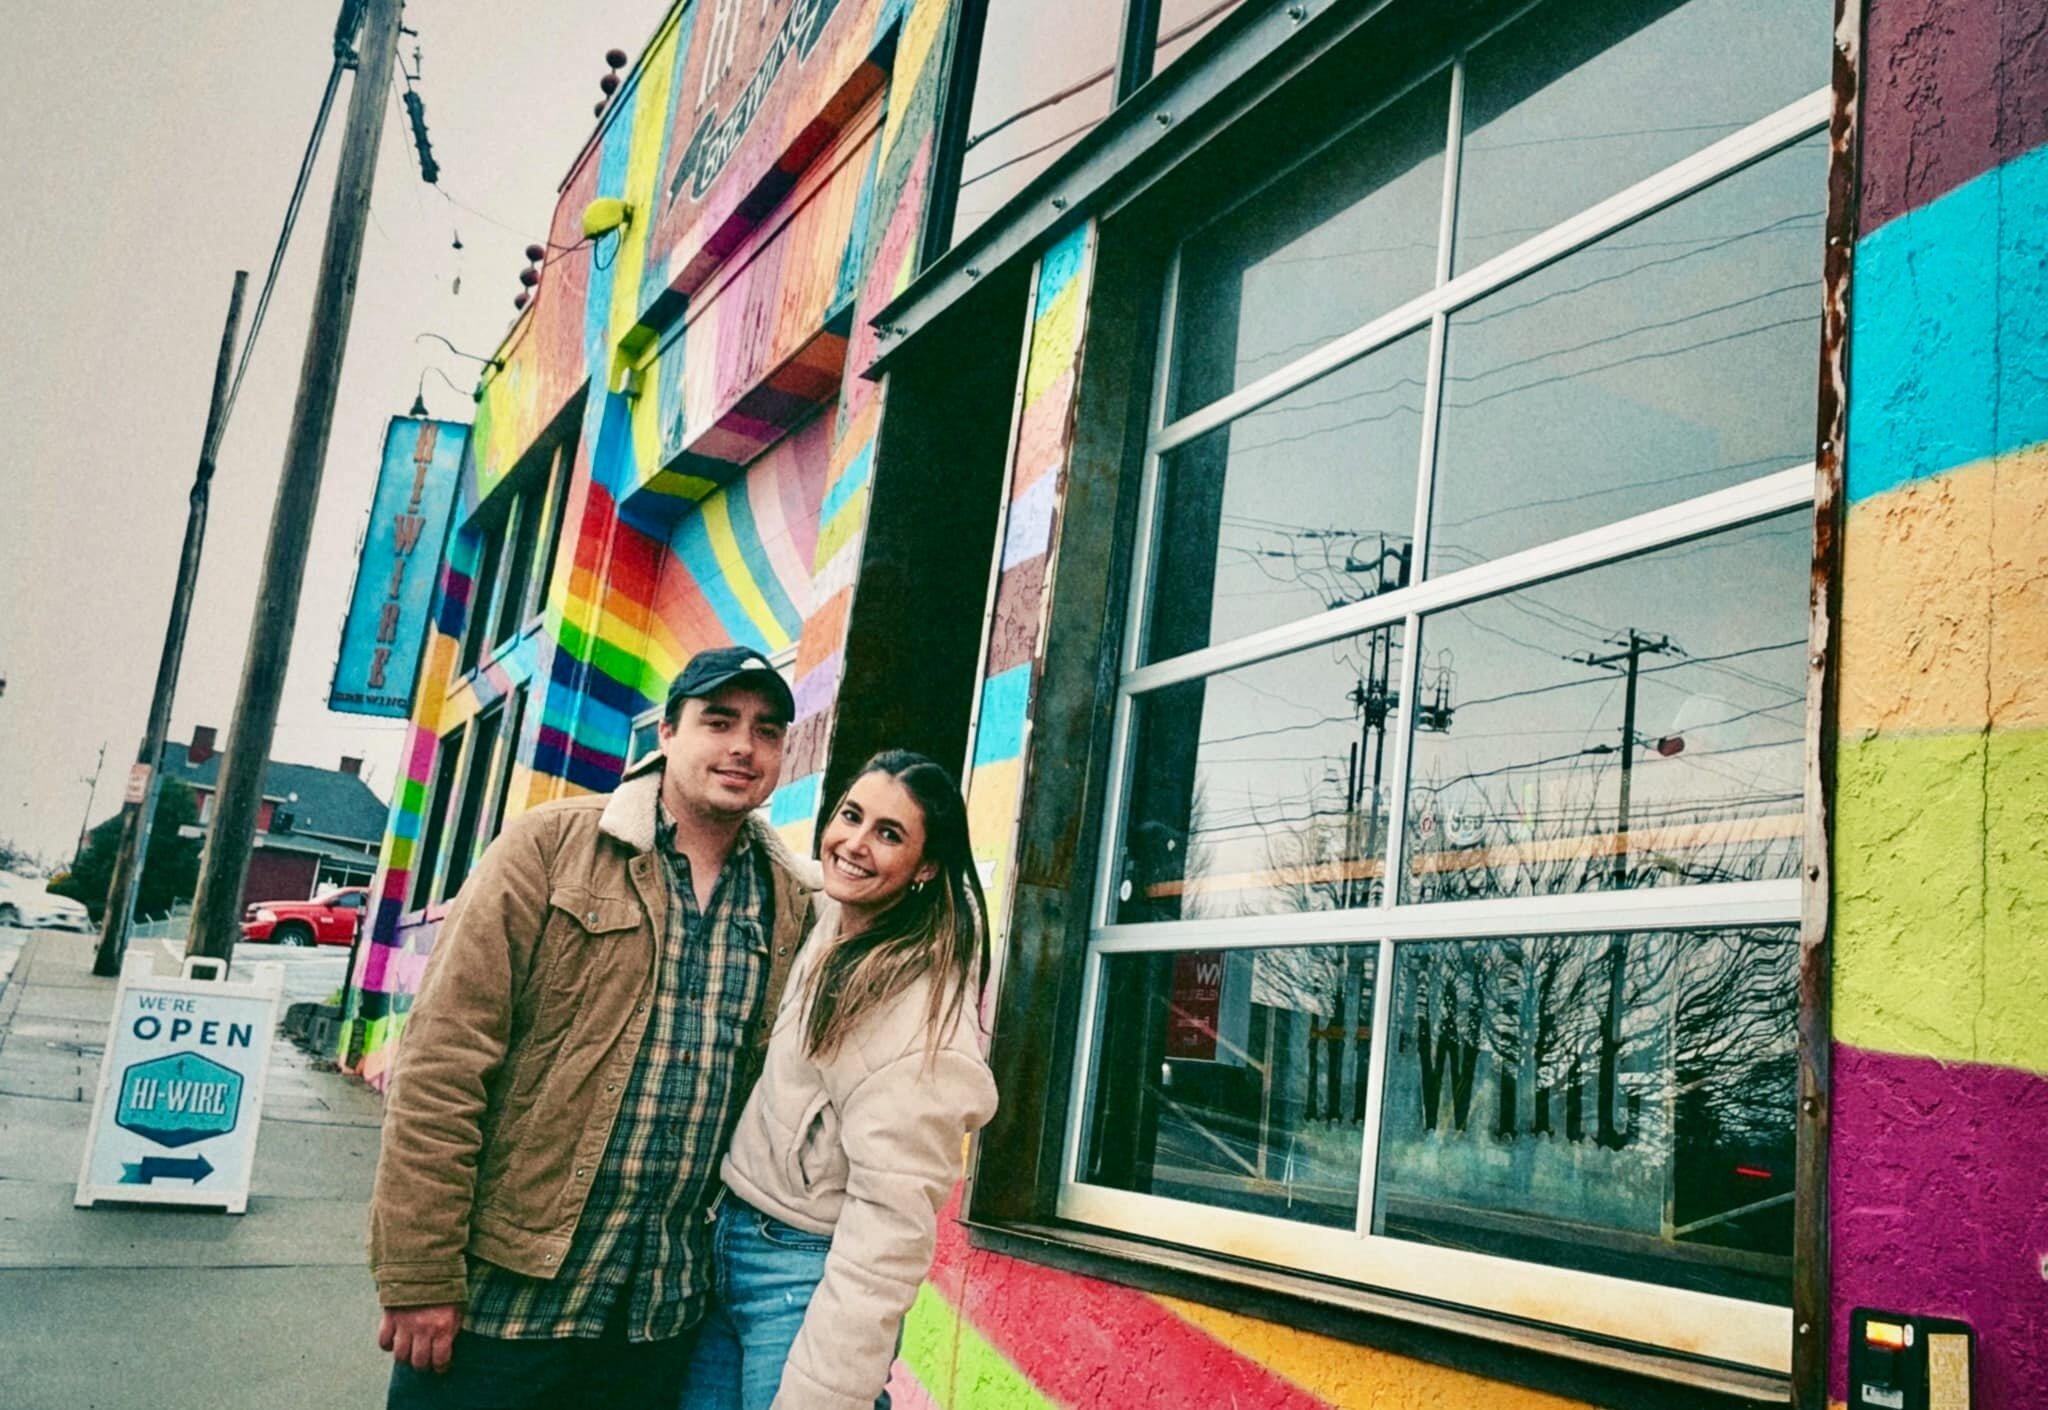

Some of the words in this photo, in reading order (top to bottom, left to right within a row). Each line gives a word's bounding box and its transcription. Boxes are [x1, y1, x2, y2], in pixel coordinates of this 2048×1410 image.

[700, 0, 808, 190] BREWING
[138, 997, 196, 1013] WE'RE
[133, 1016, 253, 1048] OPEN
[131, 1077, 229, 1115] HI-WIRE
